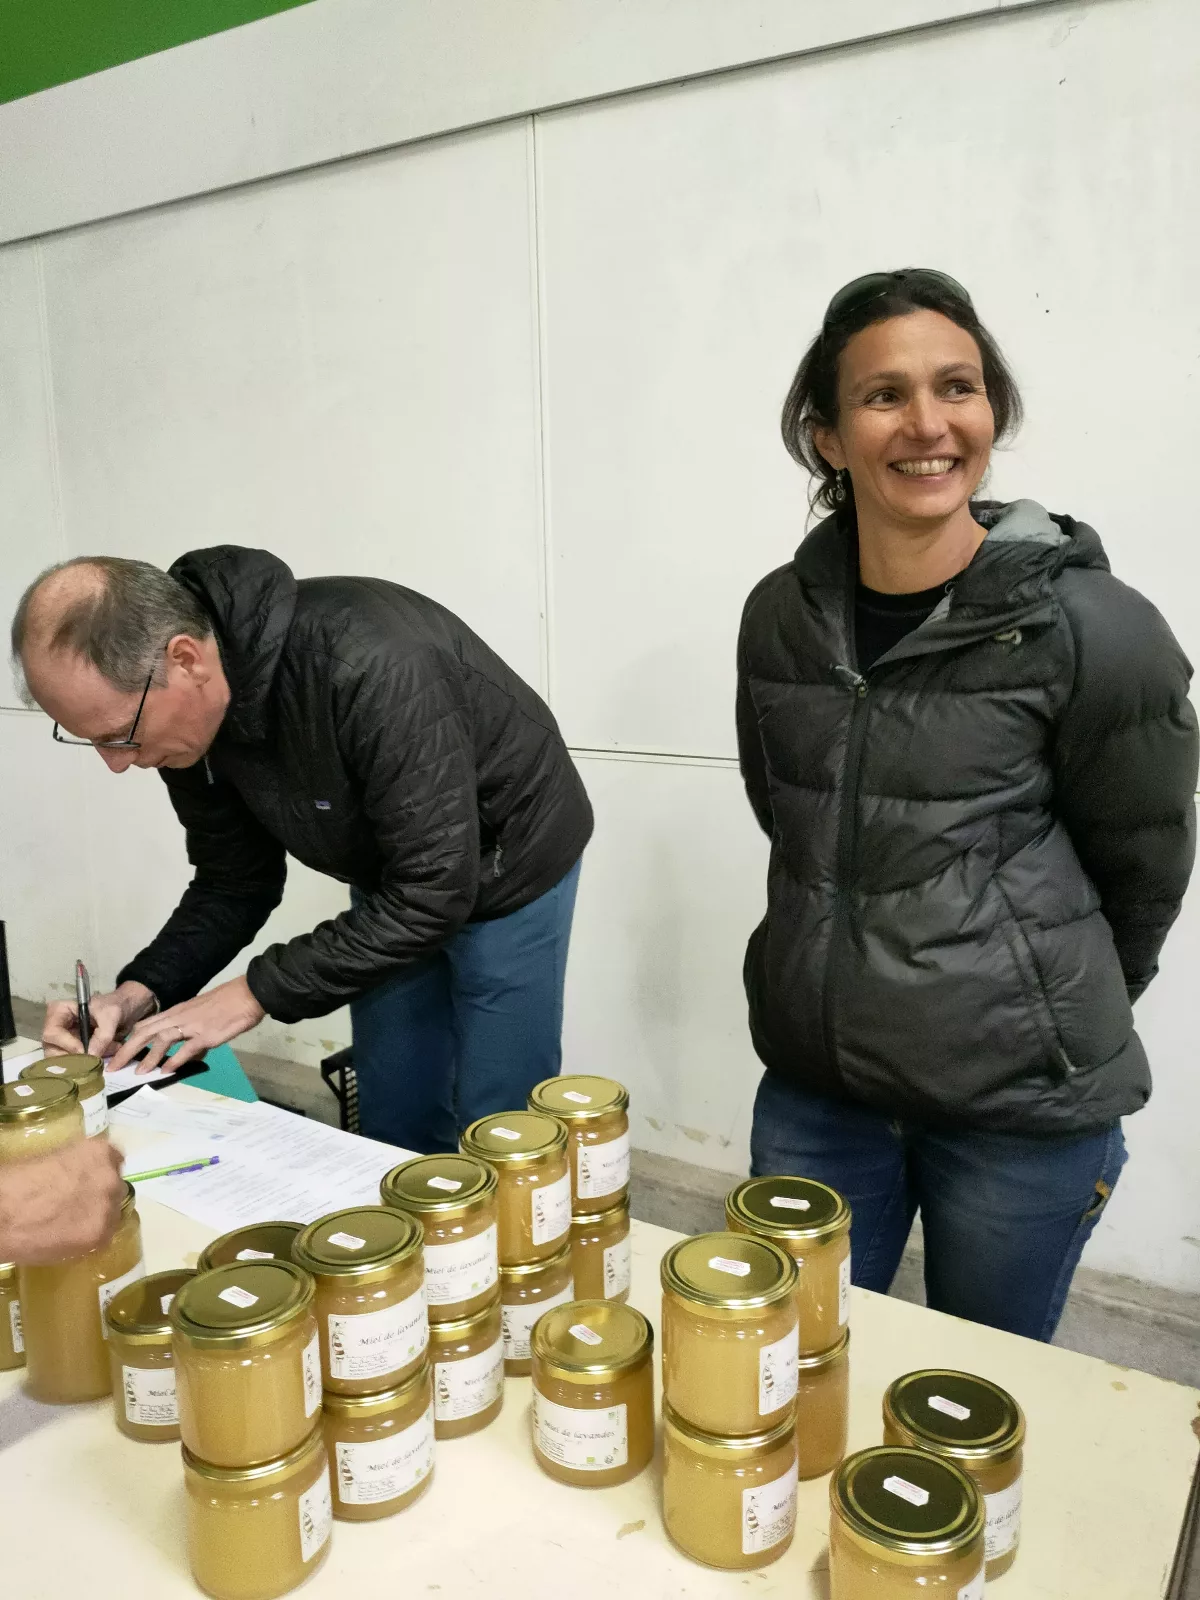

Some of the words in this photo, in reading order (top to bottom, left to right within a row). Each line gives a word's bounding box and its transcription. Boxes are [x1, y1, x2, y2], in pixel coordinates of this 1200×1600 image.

[359, 1335, 382, 1347] Miel
[384, 1331, 396, 1342] de
[561, 1428, 571, 1438] de
[365, 1461, 389, 1473] Miel
[392, 1456, 402, 1467] de
